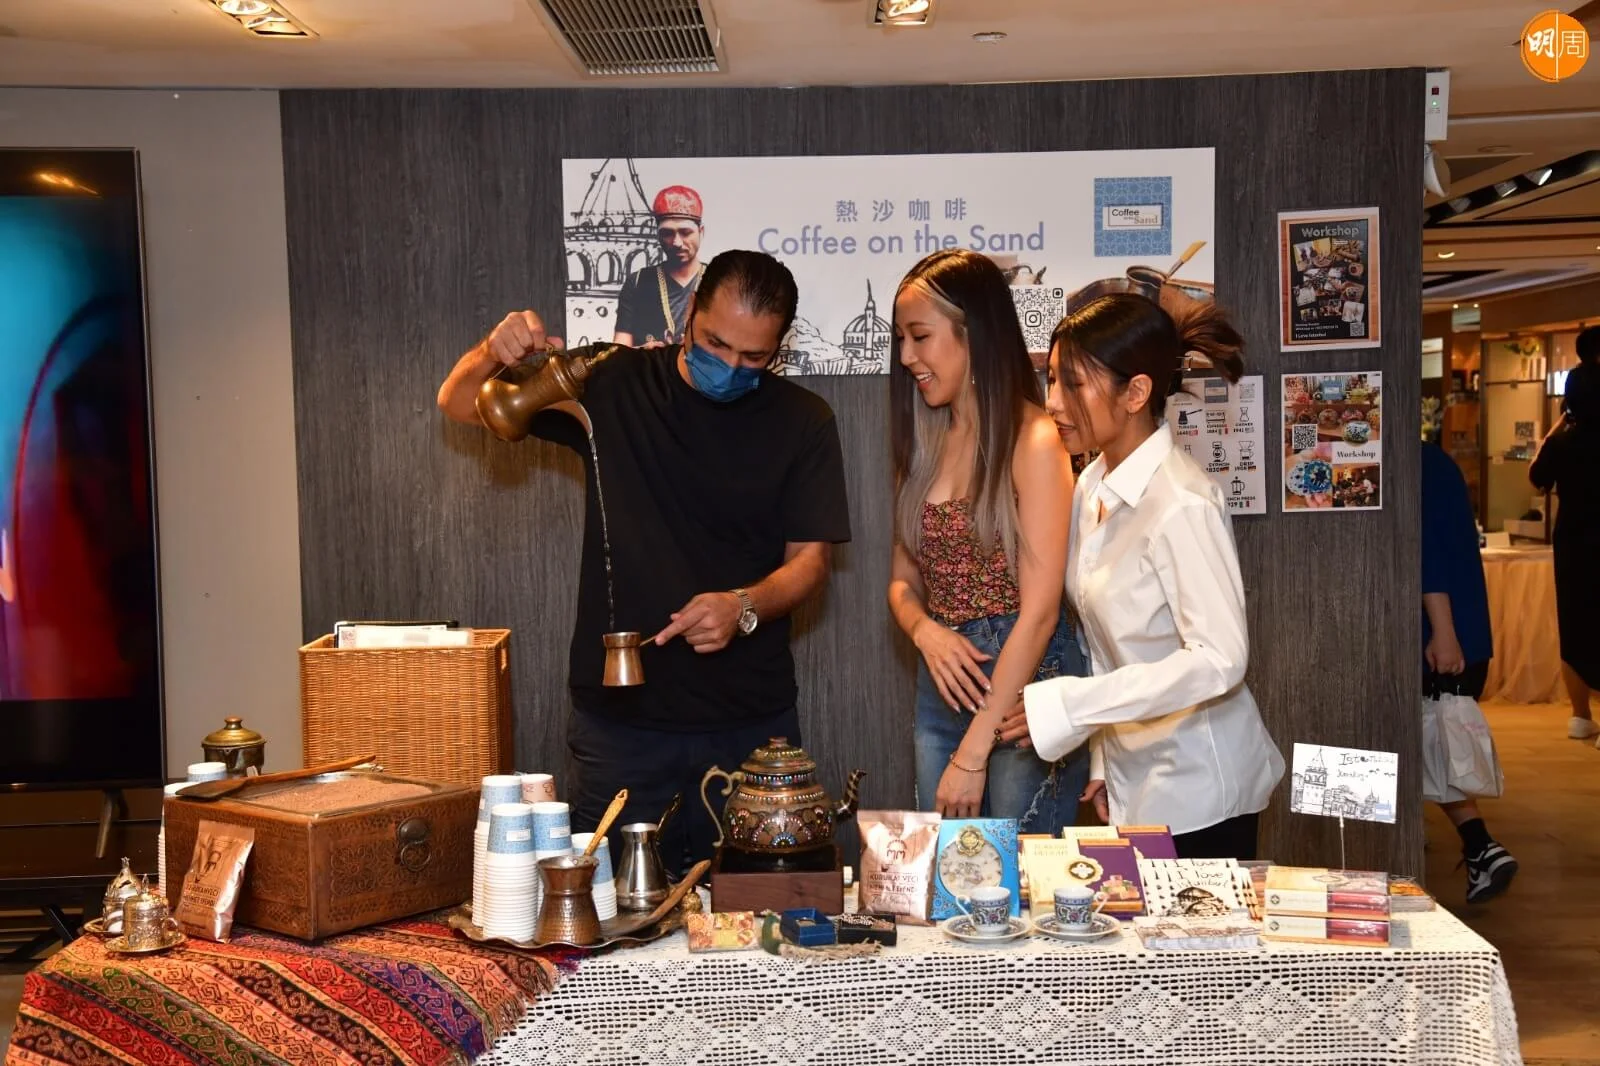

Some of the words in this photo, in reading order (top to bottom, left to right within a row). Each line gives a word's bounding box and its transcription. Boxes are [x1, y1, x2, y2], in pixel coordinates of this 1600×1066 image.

[836, 197, 967, 222] 熱沙咖啡
[1111, 208, 1139, 217] Coffee
[1134, 214, 1158, 225] Sand
[1301, 225, 1359, 238] Workshop
[758, 225, 857, 255] Coffee
[868, 235, 903, 253] on
[914, 223, 958, 252] the
[969, 221, 1044, 252] Sand
[1337, 450, 1376, 460] Workshop
